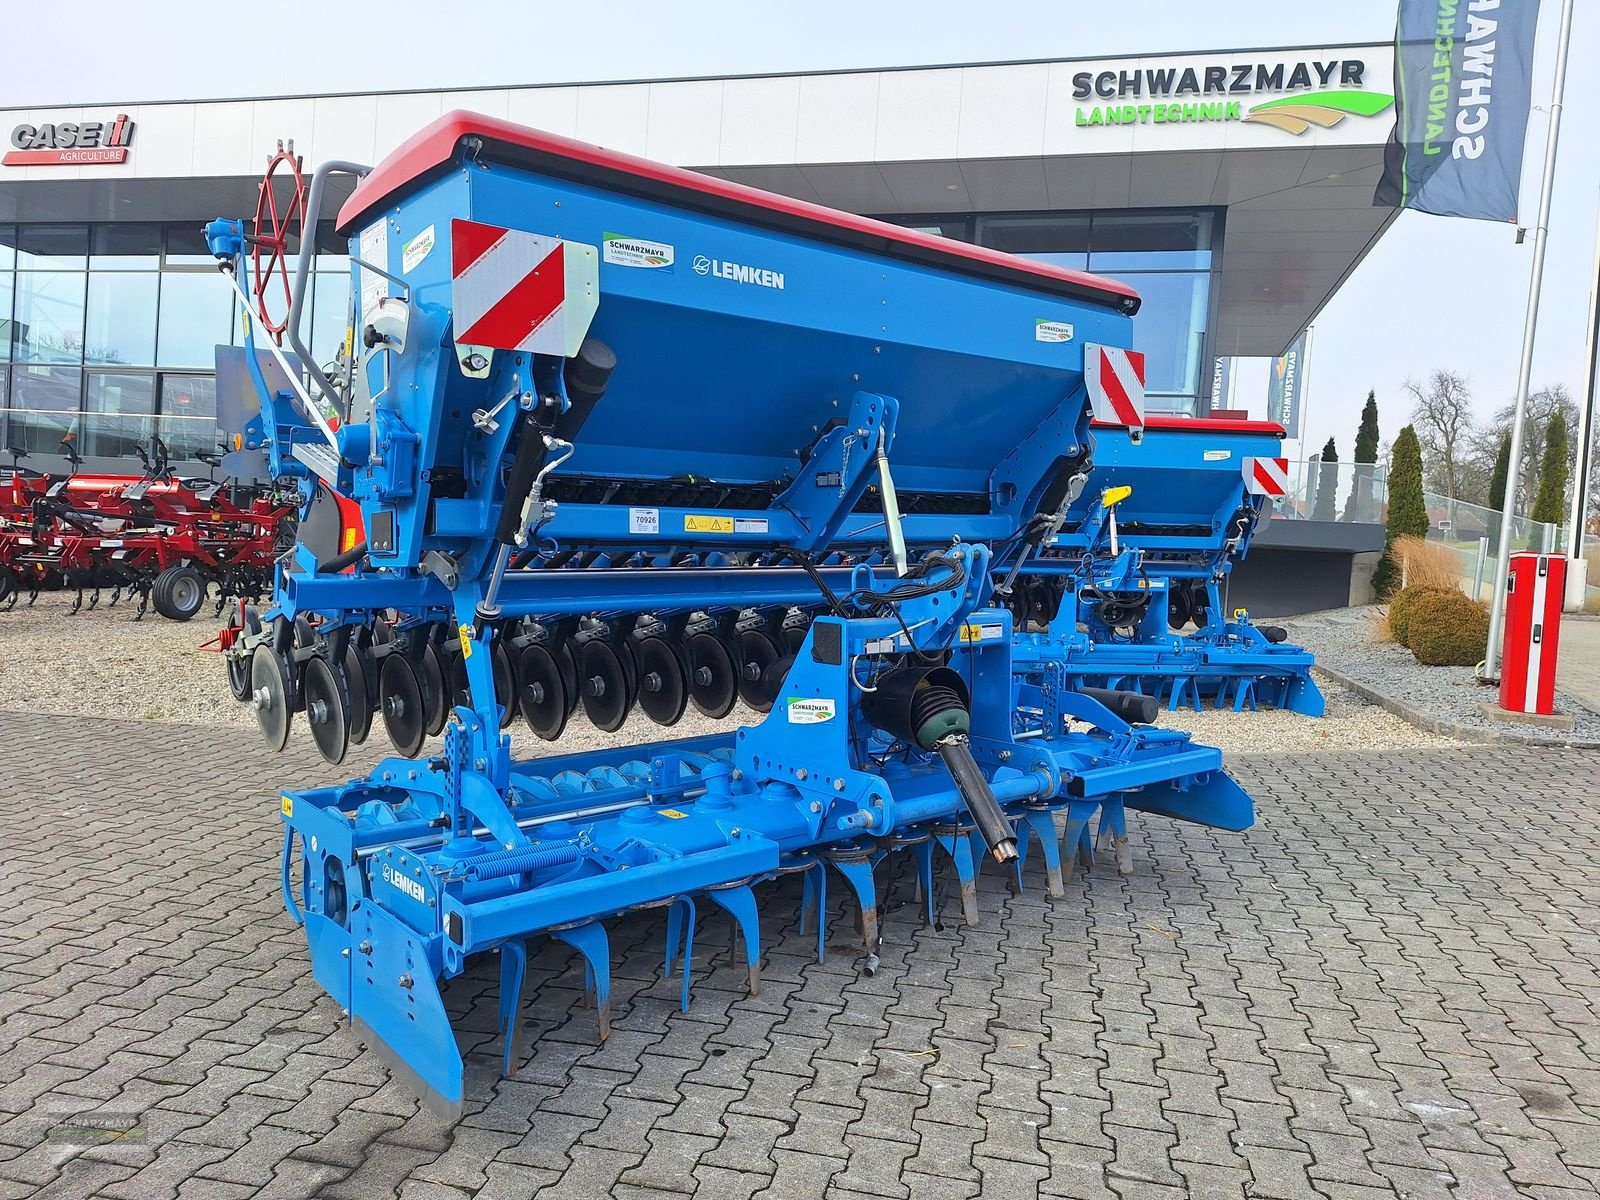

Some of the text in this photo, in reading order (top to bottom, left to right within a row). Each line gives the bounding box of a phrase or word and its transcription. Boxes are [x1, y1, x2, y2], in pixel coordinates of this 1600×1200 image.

[1072, 60, 1365, 100] SCHWARZMAYR
[1075, 101, 1241, 126] LANDTECHNIK
[11, 122, 102, 149] CASE
[60, 151, 121, 161] AGRICULTURE
[609, 240, 665, 257] SCHWARZMAYR
[611, 248, 644, 259] LANDTECHNIK
[712, 259, 785, 290] LEMKEN
[636, 516, 657, 524] 70926
[792, 703, 829, 711] SCHWARZMAYR
[390, 867, 425, 904] LEMKEN
